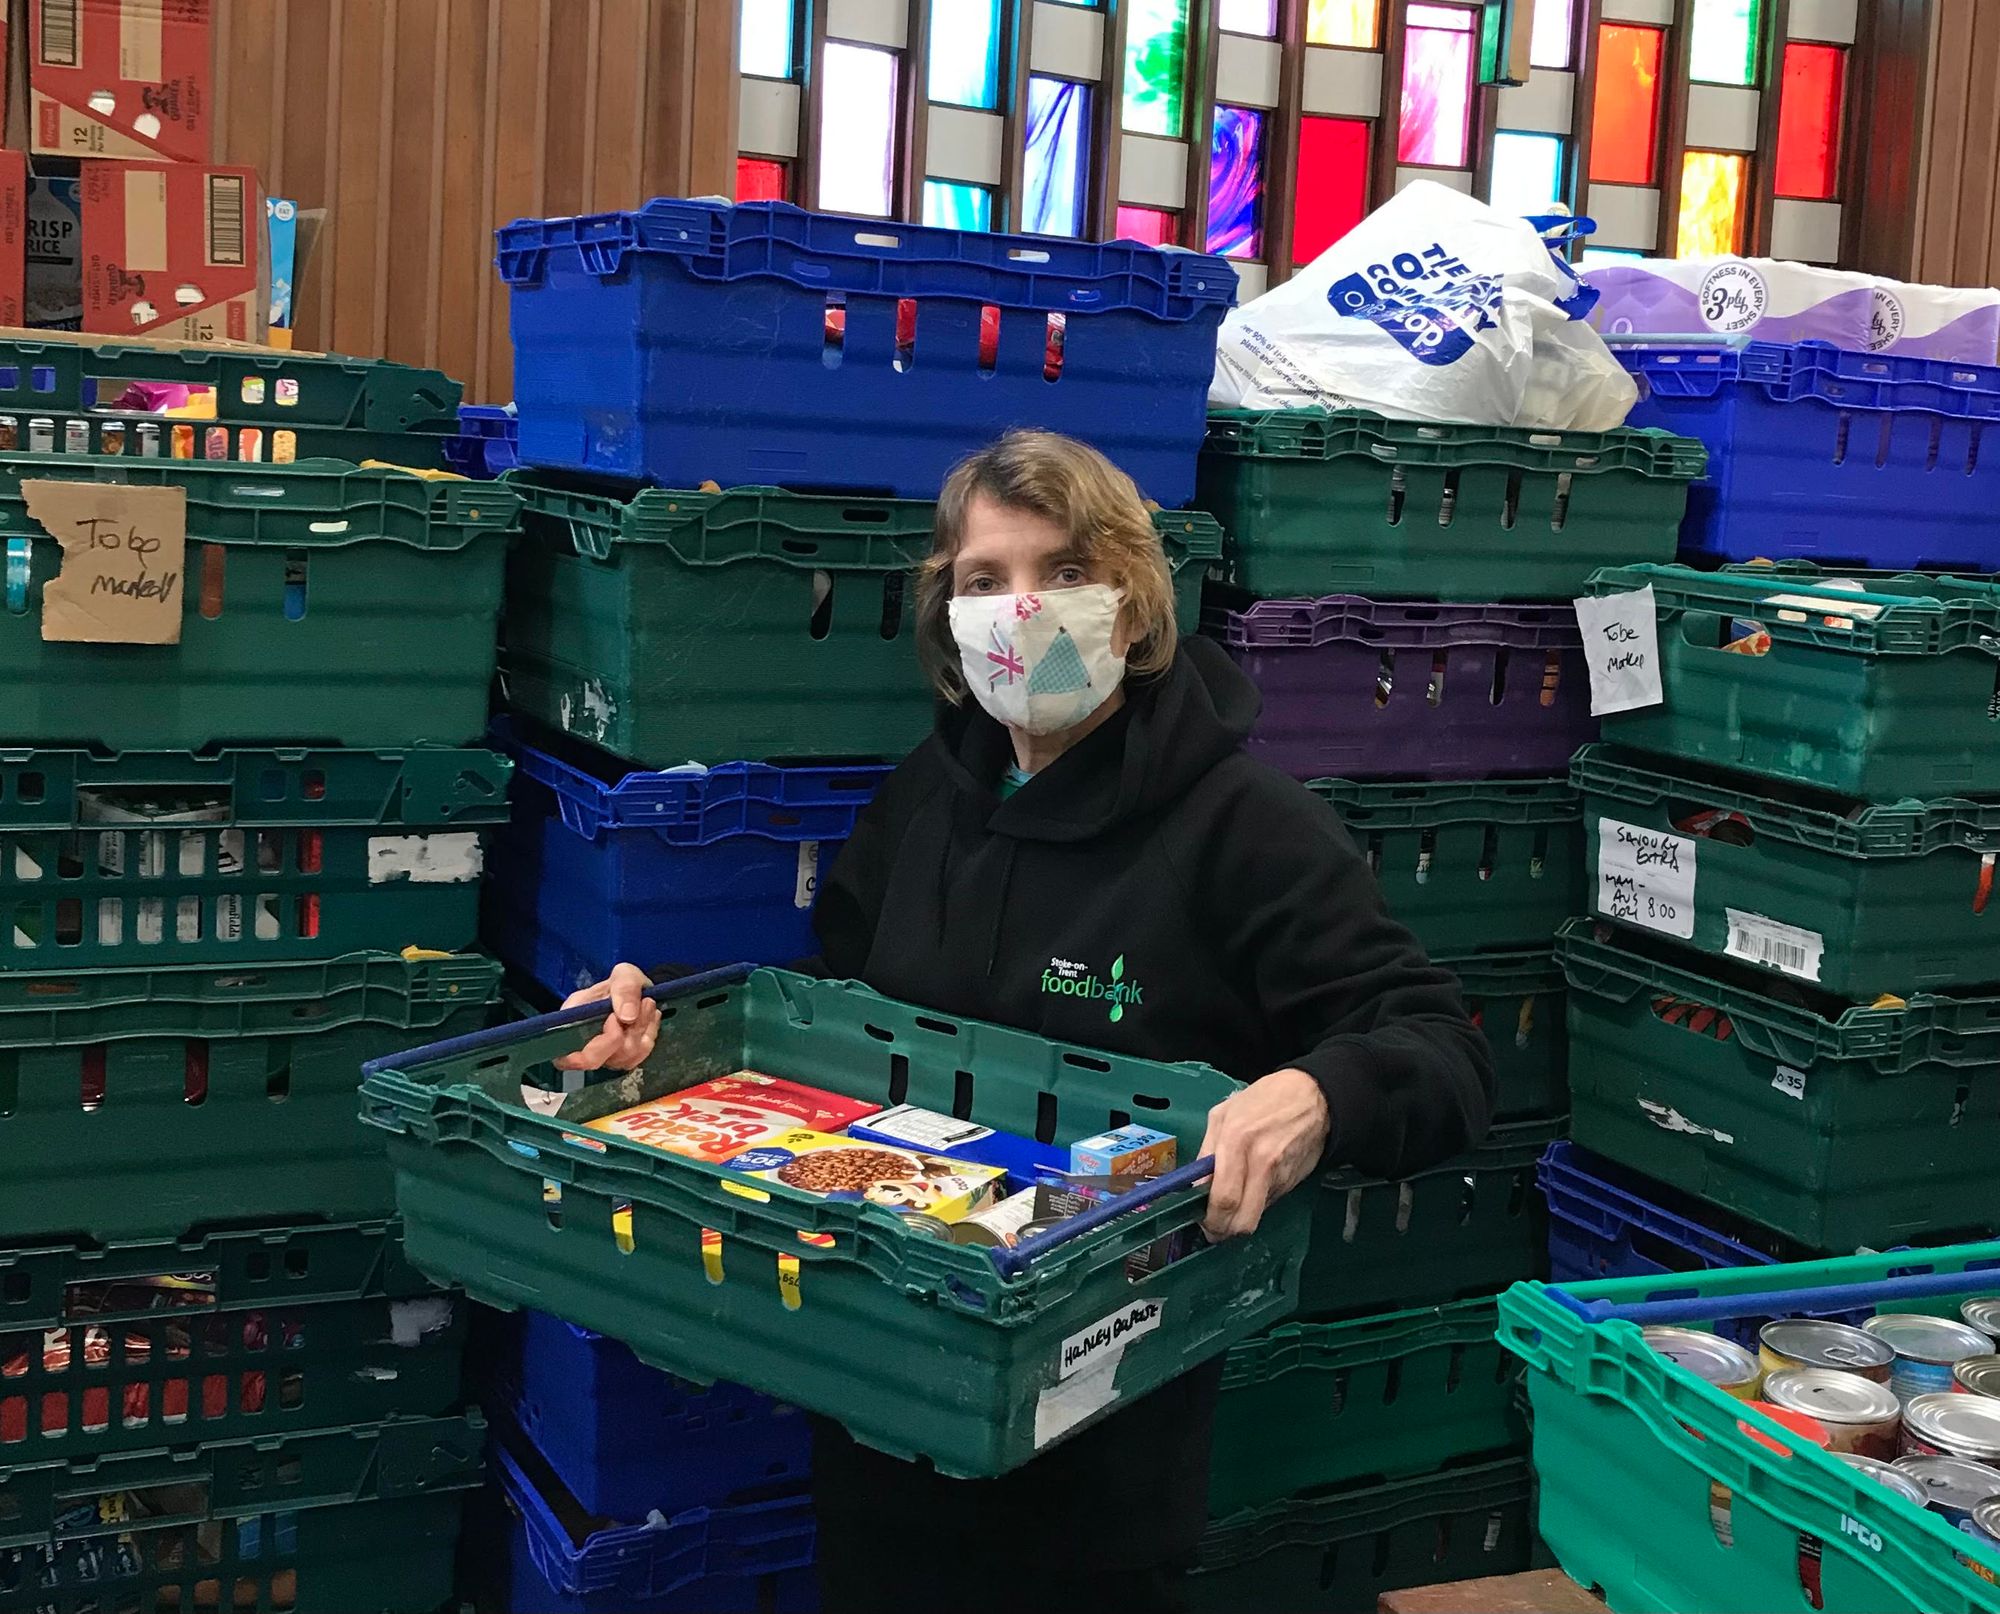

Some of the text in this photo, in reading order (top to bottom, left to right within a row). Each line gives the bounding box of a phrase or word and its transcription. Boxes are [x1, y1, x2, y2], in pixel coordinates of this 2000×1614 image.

[73, 127, 88, 145] 12
[27, 219, 73, 239] RISP
[26, 239, 61, 254] RICE
[1702, 266, 1763, 331] SOFTNESS IN EVERY SHEET
[200, 324, 213, 341] 12
[1869, 291, 1900, 351] IN EVERY SHEE
[1871, 311, 1886, 336] ly
[1252, 330, 1268, 347] 90%
[1240, 338, 1260, 357] plastic
[1259, 352, 1274, 366] and
[76, 518, 120, 550] To
[1617, 826, 1680, 852] SAVOURY
[1636, 847, 1680, 874] EXTRA
[1050, 957, 1089, 971] Stoke-on-
[1058, 966, 1079, 978] Trent
[1041, 969, 1144, 1005] foodbank
[612, 1111, 747, 1155] Ready
[660, 1101, 768, 1140] brek
[735, 1154, 785, 1168] 30%
[783, 1273, 800, 1287] 75g
[1840, 1513, 1883, 1552] IFCO
